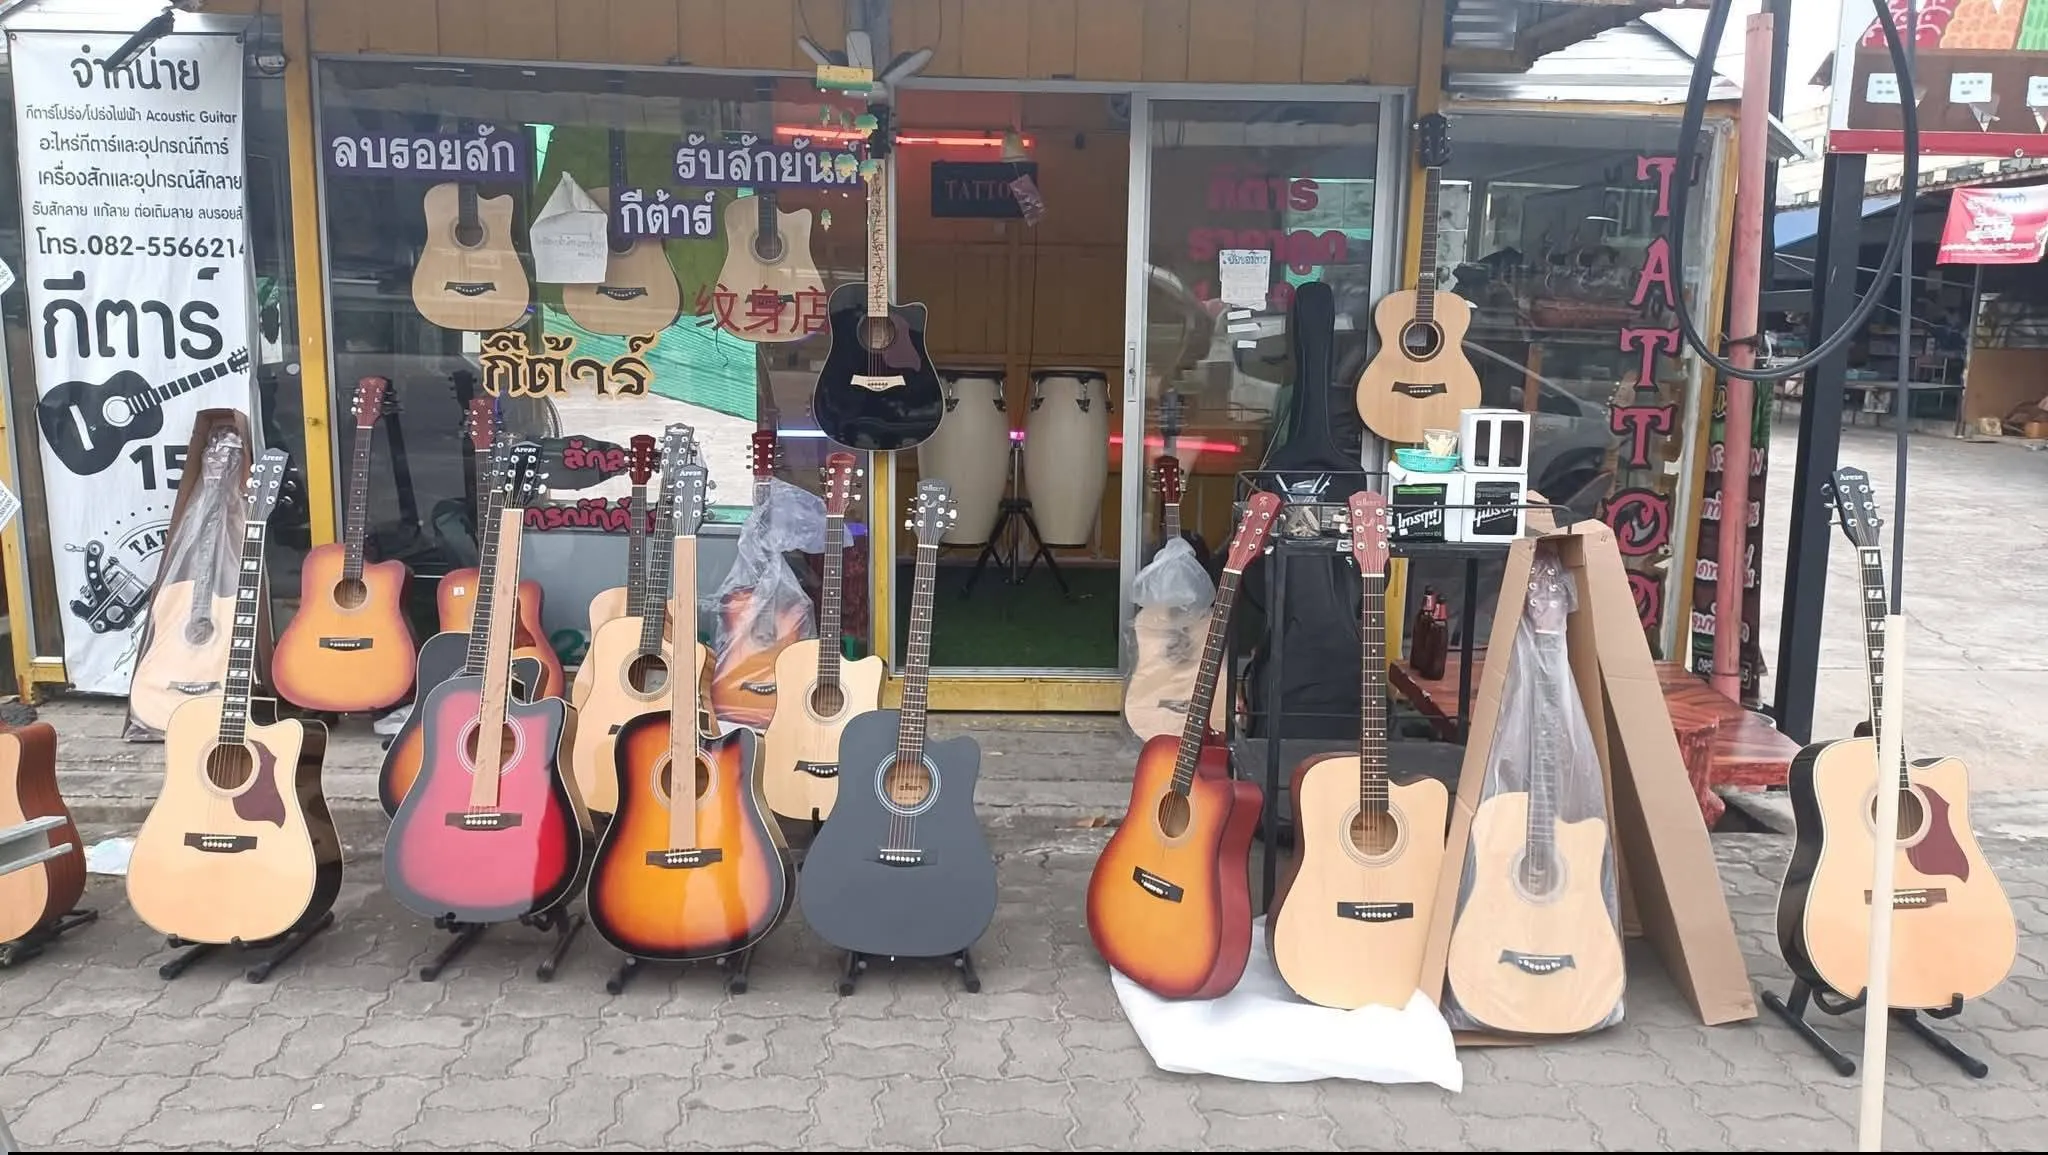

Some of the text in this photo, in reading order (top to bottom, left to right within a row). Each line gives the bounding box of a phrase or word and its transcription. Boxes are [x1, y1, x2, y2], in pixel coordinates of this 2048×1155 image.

[146, 110, 195, 123] Acoustic
[199, 110, 238, 124] Guitar
[331, 123, 516, 173] ลบรอยสัก
[38, 161, 243, 194] เครื่องสักและอุปกรณ์สักลาย
[943, 178, 1013, 202] TATTO
[32, 200, 88, 217] รับสักลาย
[94, 201, 130, 218] แก้ลาย
[620, 188, 716, 236] กีต้าร์
[43, 266, 224, 361] กีตาร์
[693, 283, 831, 335] 纹身店
[480, 329, 659, 400] กีต้าร์
